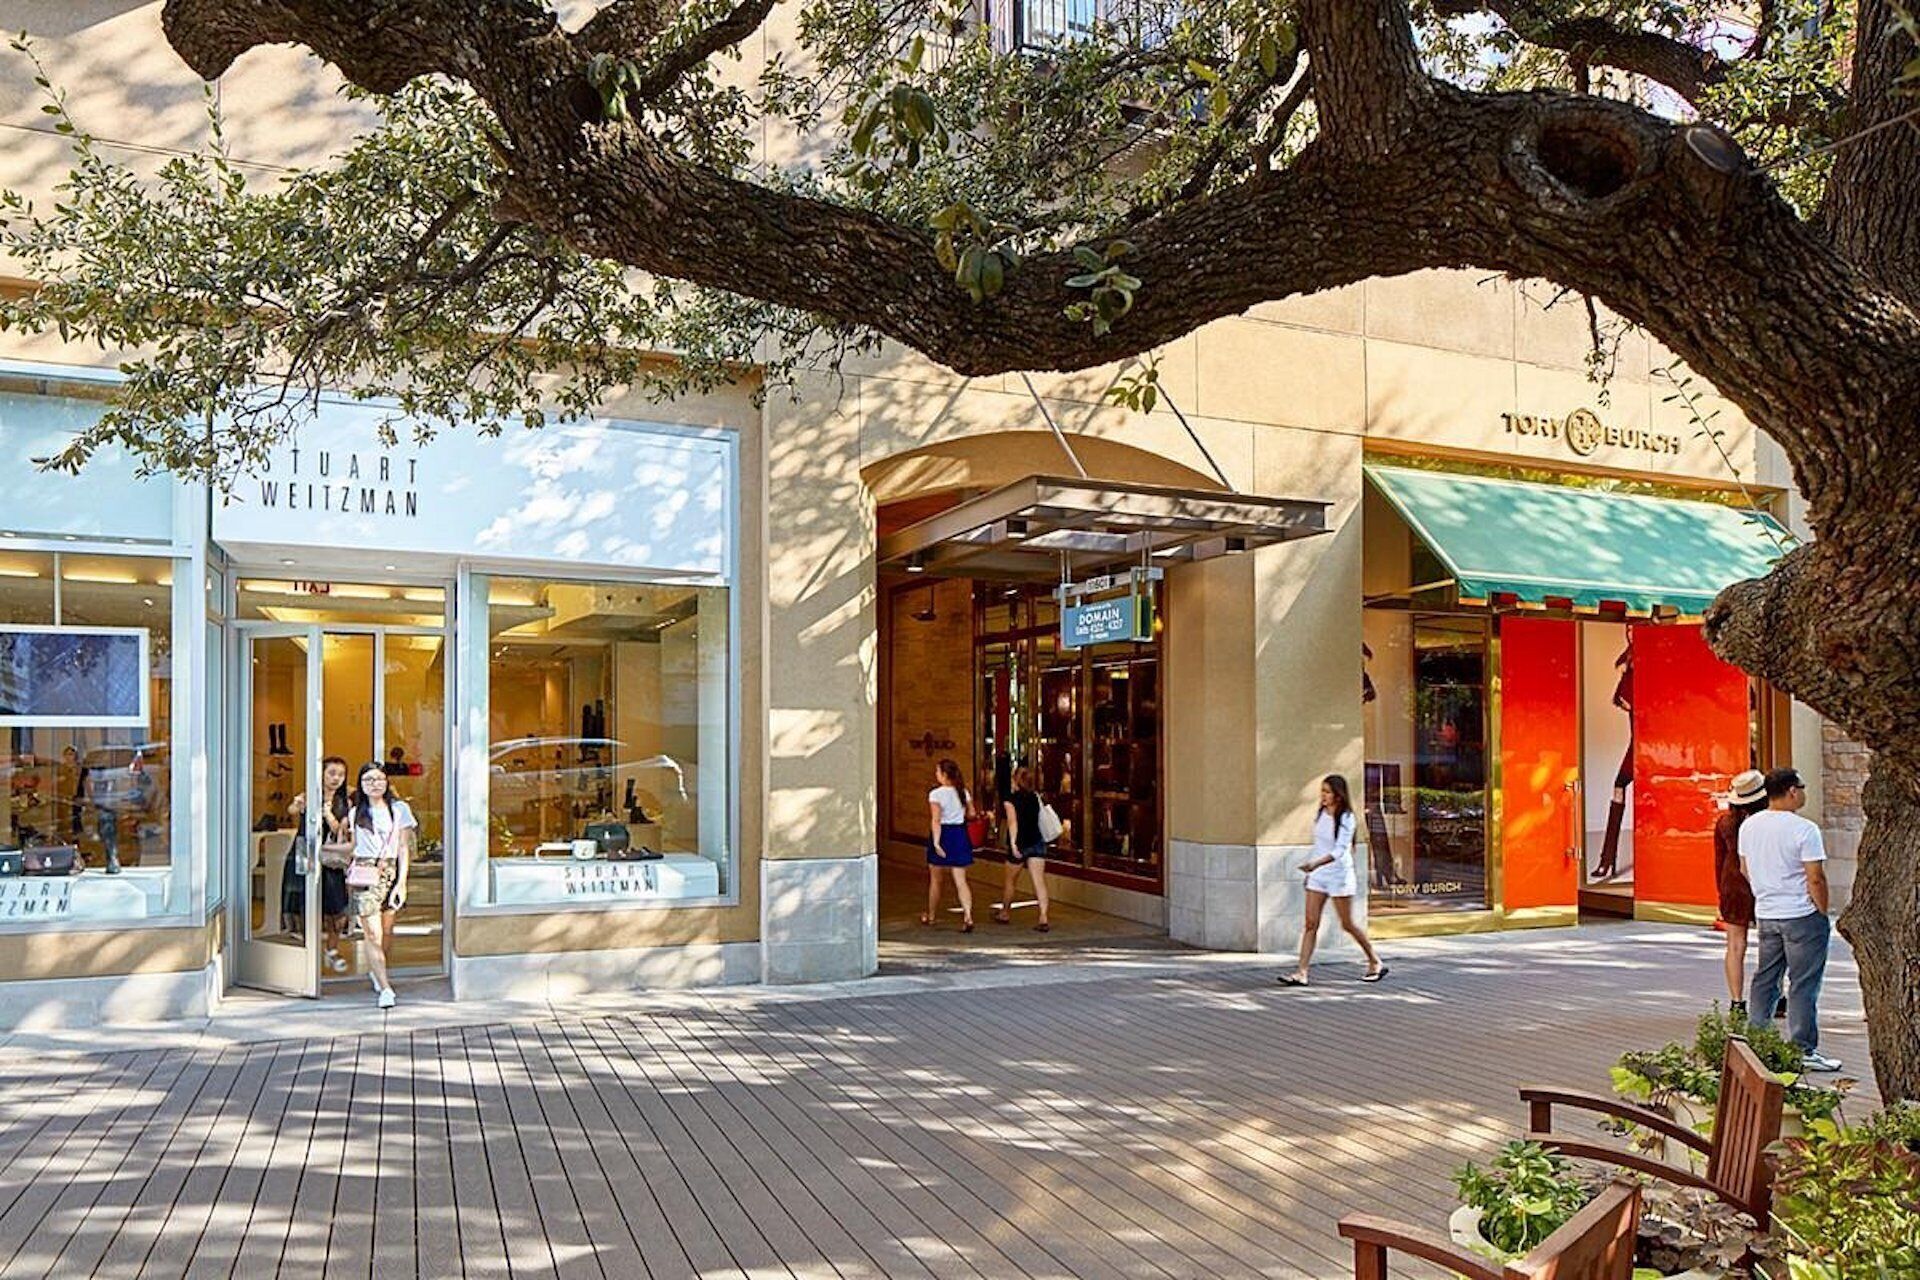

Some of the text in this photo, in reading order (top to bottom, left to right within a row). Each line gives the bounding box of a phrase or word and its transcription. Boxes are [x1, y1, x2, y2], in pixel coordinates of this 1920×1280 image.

[1500, 412, 1682, 454] TORY BURCH
[261, 449, 417, 484] STUART
[261, 480, 417, 517] WEITZMAN
[1078, 608, 1120, 626] DOMAIN
[564, 864, 651, 878] STUART
[566, 878, 654, 894] WEITZMAN
[1390, 882, 1462, 895] TORY BURCH
